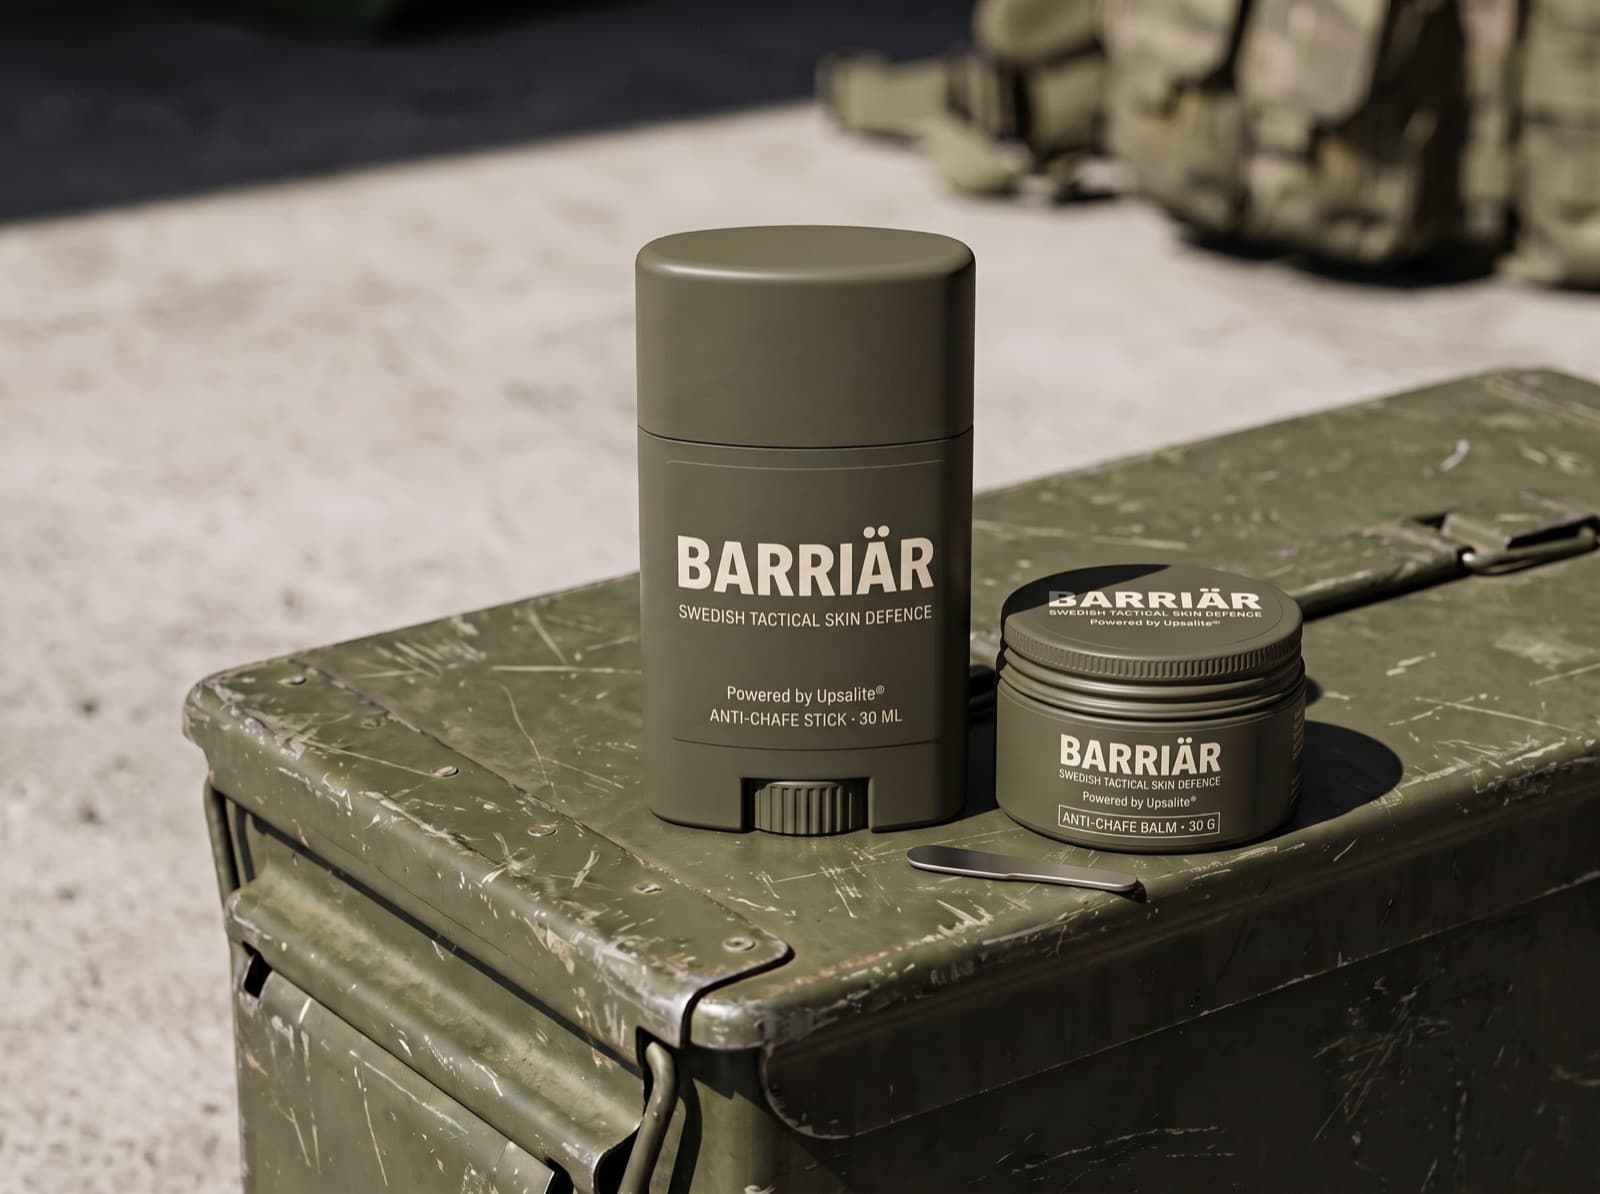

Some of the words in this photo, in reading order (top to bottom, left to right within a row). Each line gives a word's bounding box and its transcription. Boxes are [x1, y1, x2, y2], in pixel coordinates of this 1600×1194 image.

[678, 525, 934, 596] BARRIÄR
[1049, 588, 1262, 609] BARRIÄR
[679, 604, 744, 624] SWEDISH
[749, 612, 820, 627] TACTICAL
[825, 611, 860, 627] SKIN
[866, 605, 932, 625] DEFENCE
[1146, 619, 1160, 627] by
[728, 686, 790, 703] Powered
[796, 688, 812, 706] by
[710, 709, 799, 727] ANTI-CHAFE
[804, 712, 846, 727] STICK
[860, 711, 876, 725] 30
[882, 709, 902, 723] ML
[1060, 733, 1222, 776] BARRIÄR
[1059, 769, 1101, 785] SWEDISH
[1104, 777, 1149, 789] TACTICAL
[1152, 780, 1174, 790] SKIN
[1178, 776, 1221, 789] DEFENCE
[1083, 791, 1127, 806] Powered
[1131, 796, 1143, 810] by
[1062, 811, 1137, 833] ANTI-CHAFE
[1141, 822, 1176, 833] BALM
[1189, 820, 1203, 831] 30
[1207, 818, 1215, 830] G
